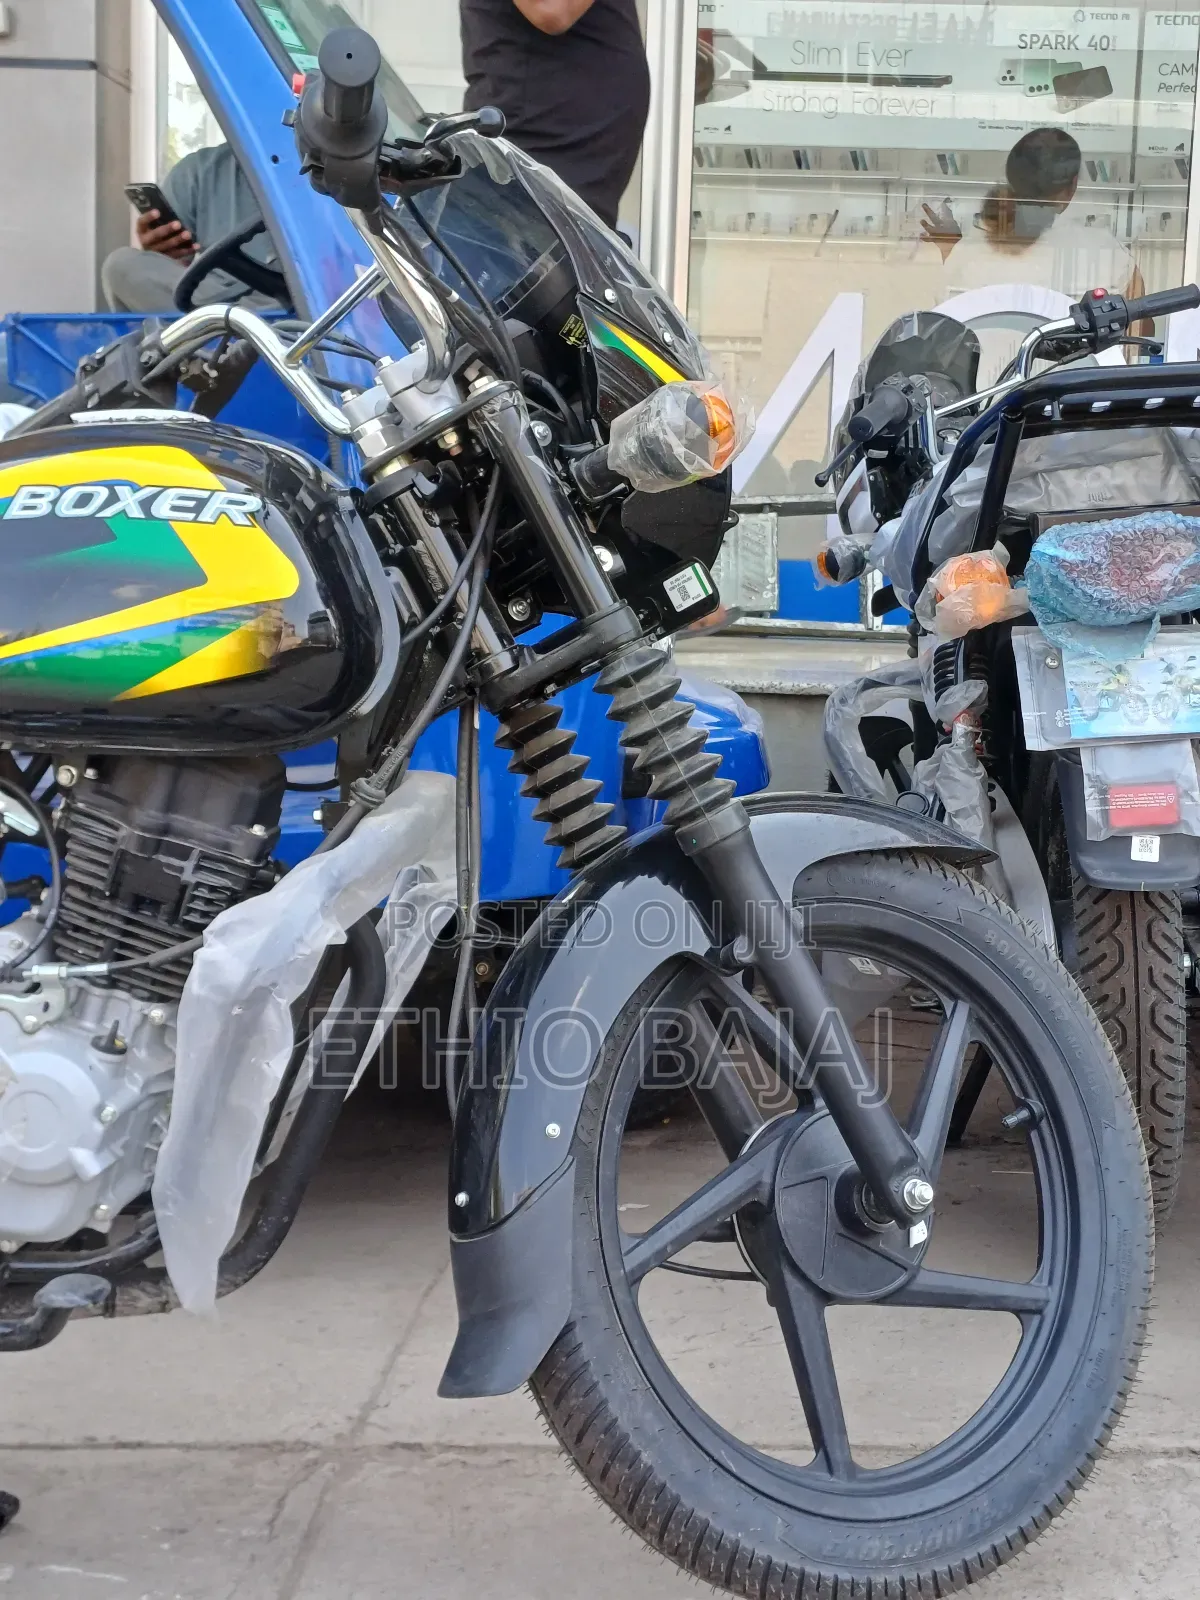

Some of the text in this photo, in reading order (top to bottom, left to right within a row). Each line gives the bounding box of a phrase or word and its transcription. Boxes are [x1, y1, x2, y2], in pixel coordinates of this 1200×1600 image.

[1090, 12, 1118, 21] TECNO
[790, 39, 913, 68] Slim Ever
[1017, 33, 1080, 51] SPARK
[1087, 34, 1111, 51] 40
[1158, 62, 1198, 77] CAM
[762, 89, 938, 119] Strong Forever
[2, 483, 263, 527] BOXER
